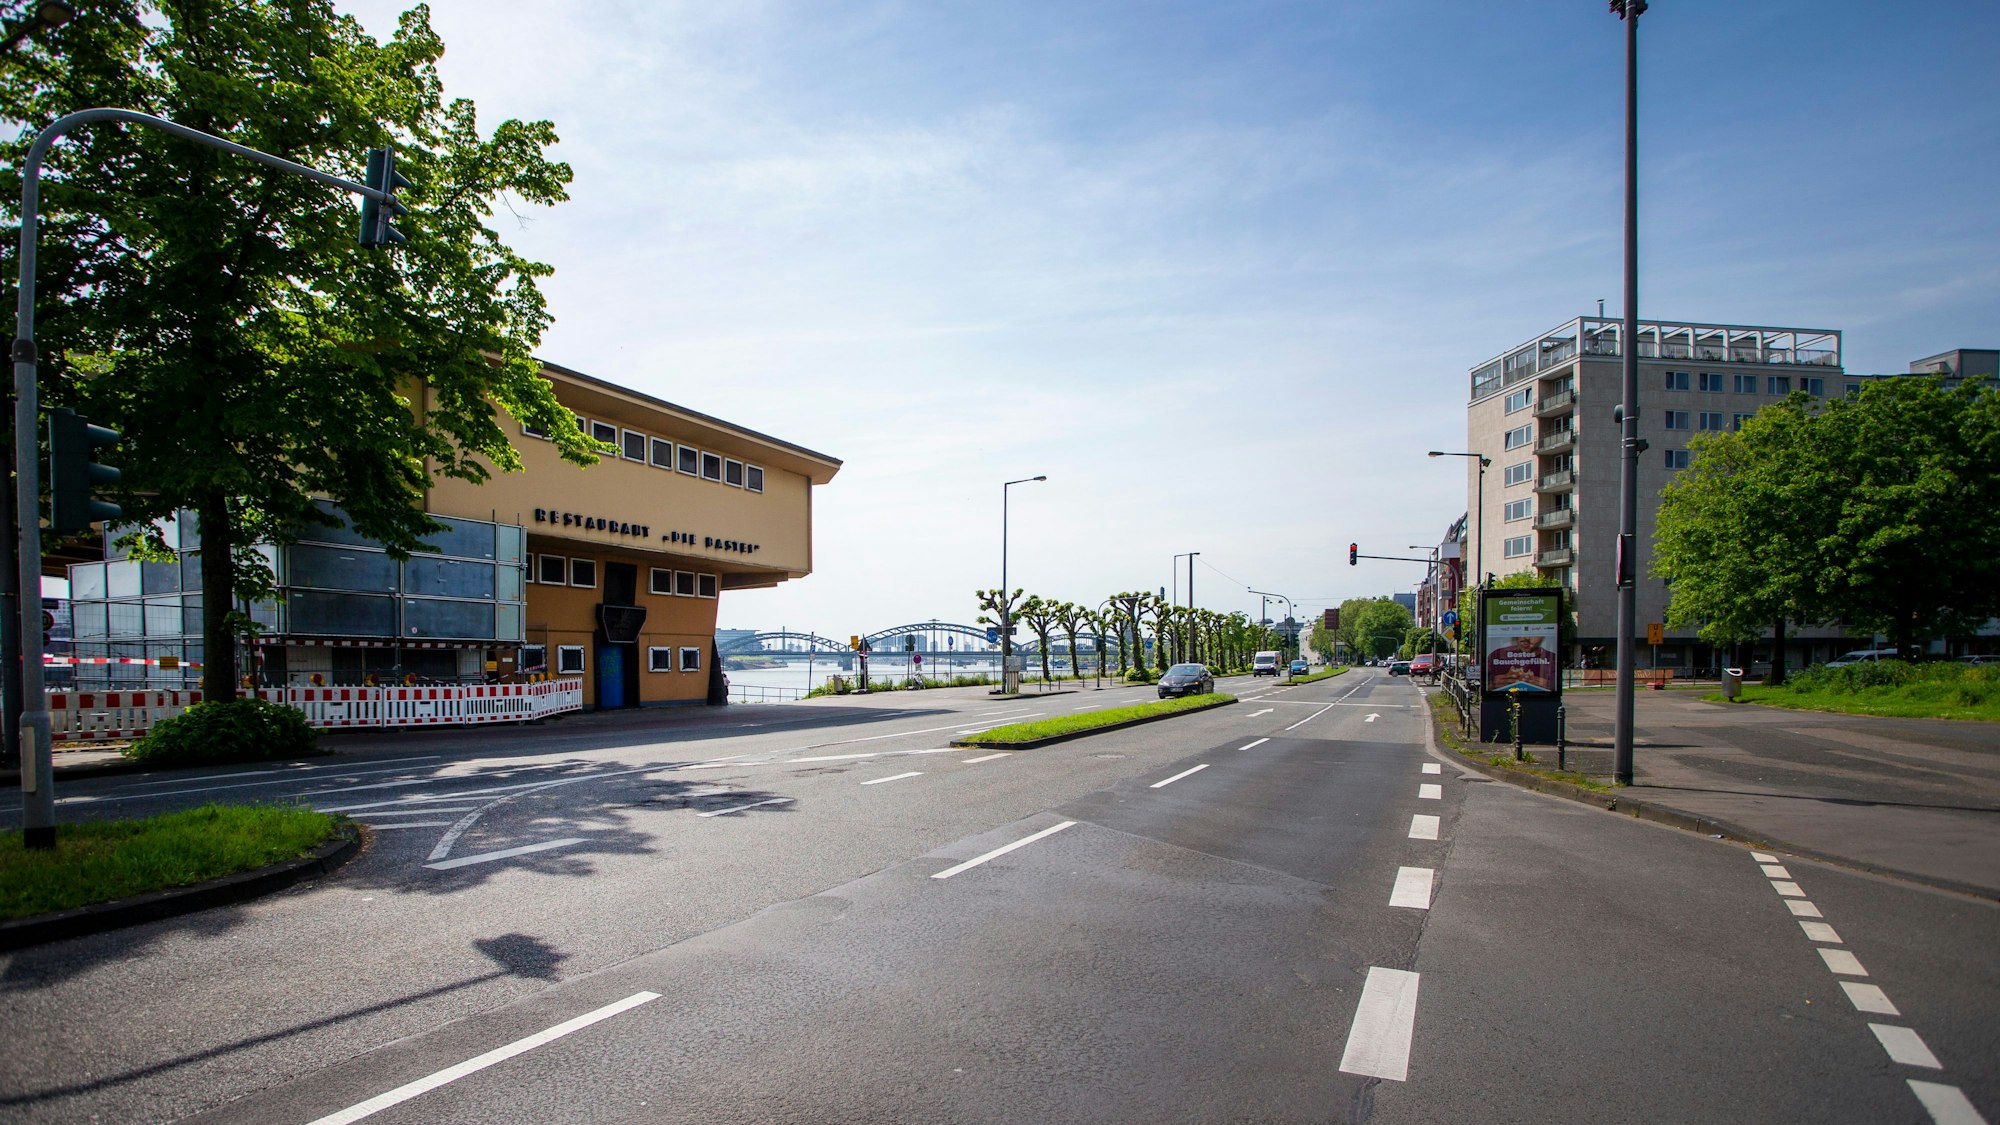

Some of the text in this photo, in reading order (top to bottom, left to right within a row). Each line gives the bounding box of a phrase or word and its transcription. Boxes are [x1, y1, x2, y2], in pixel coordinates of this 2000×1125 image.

[535, 508, 650, 537] RESTAURANT
[1498, 598, 1544, 606] Gemeinschaft
[1492, 657, 1550, 666] Bauchgefühl.
